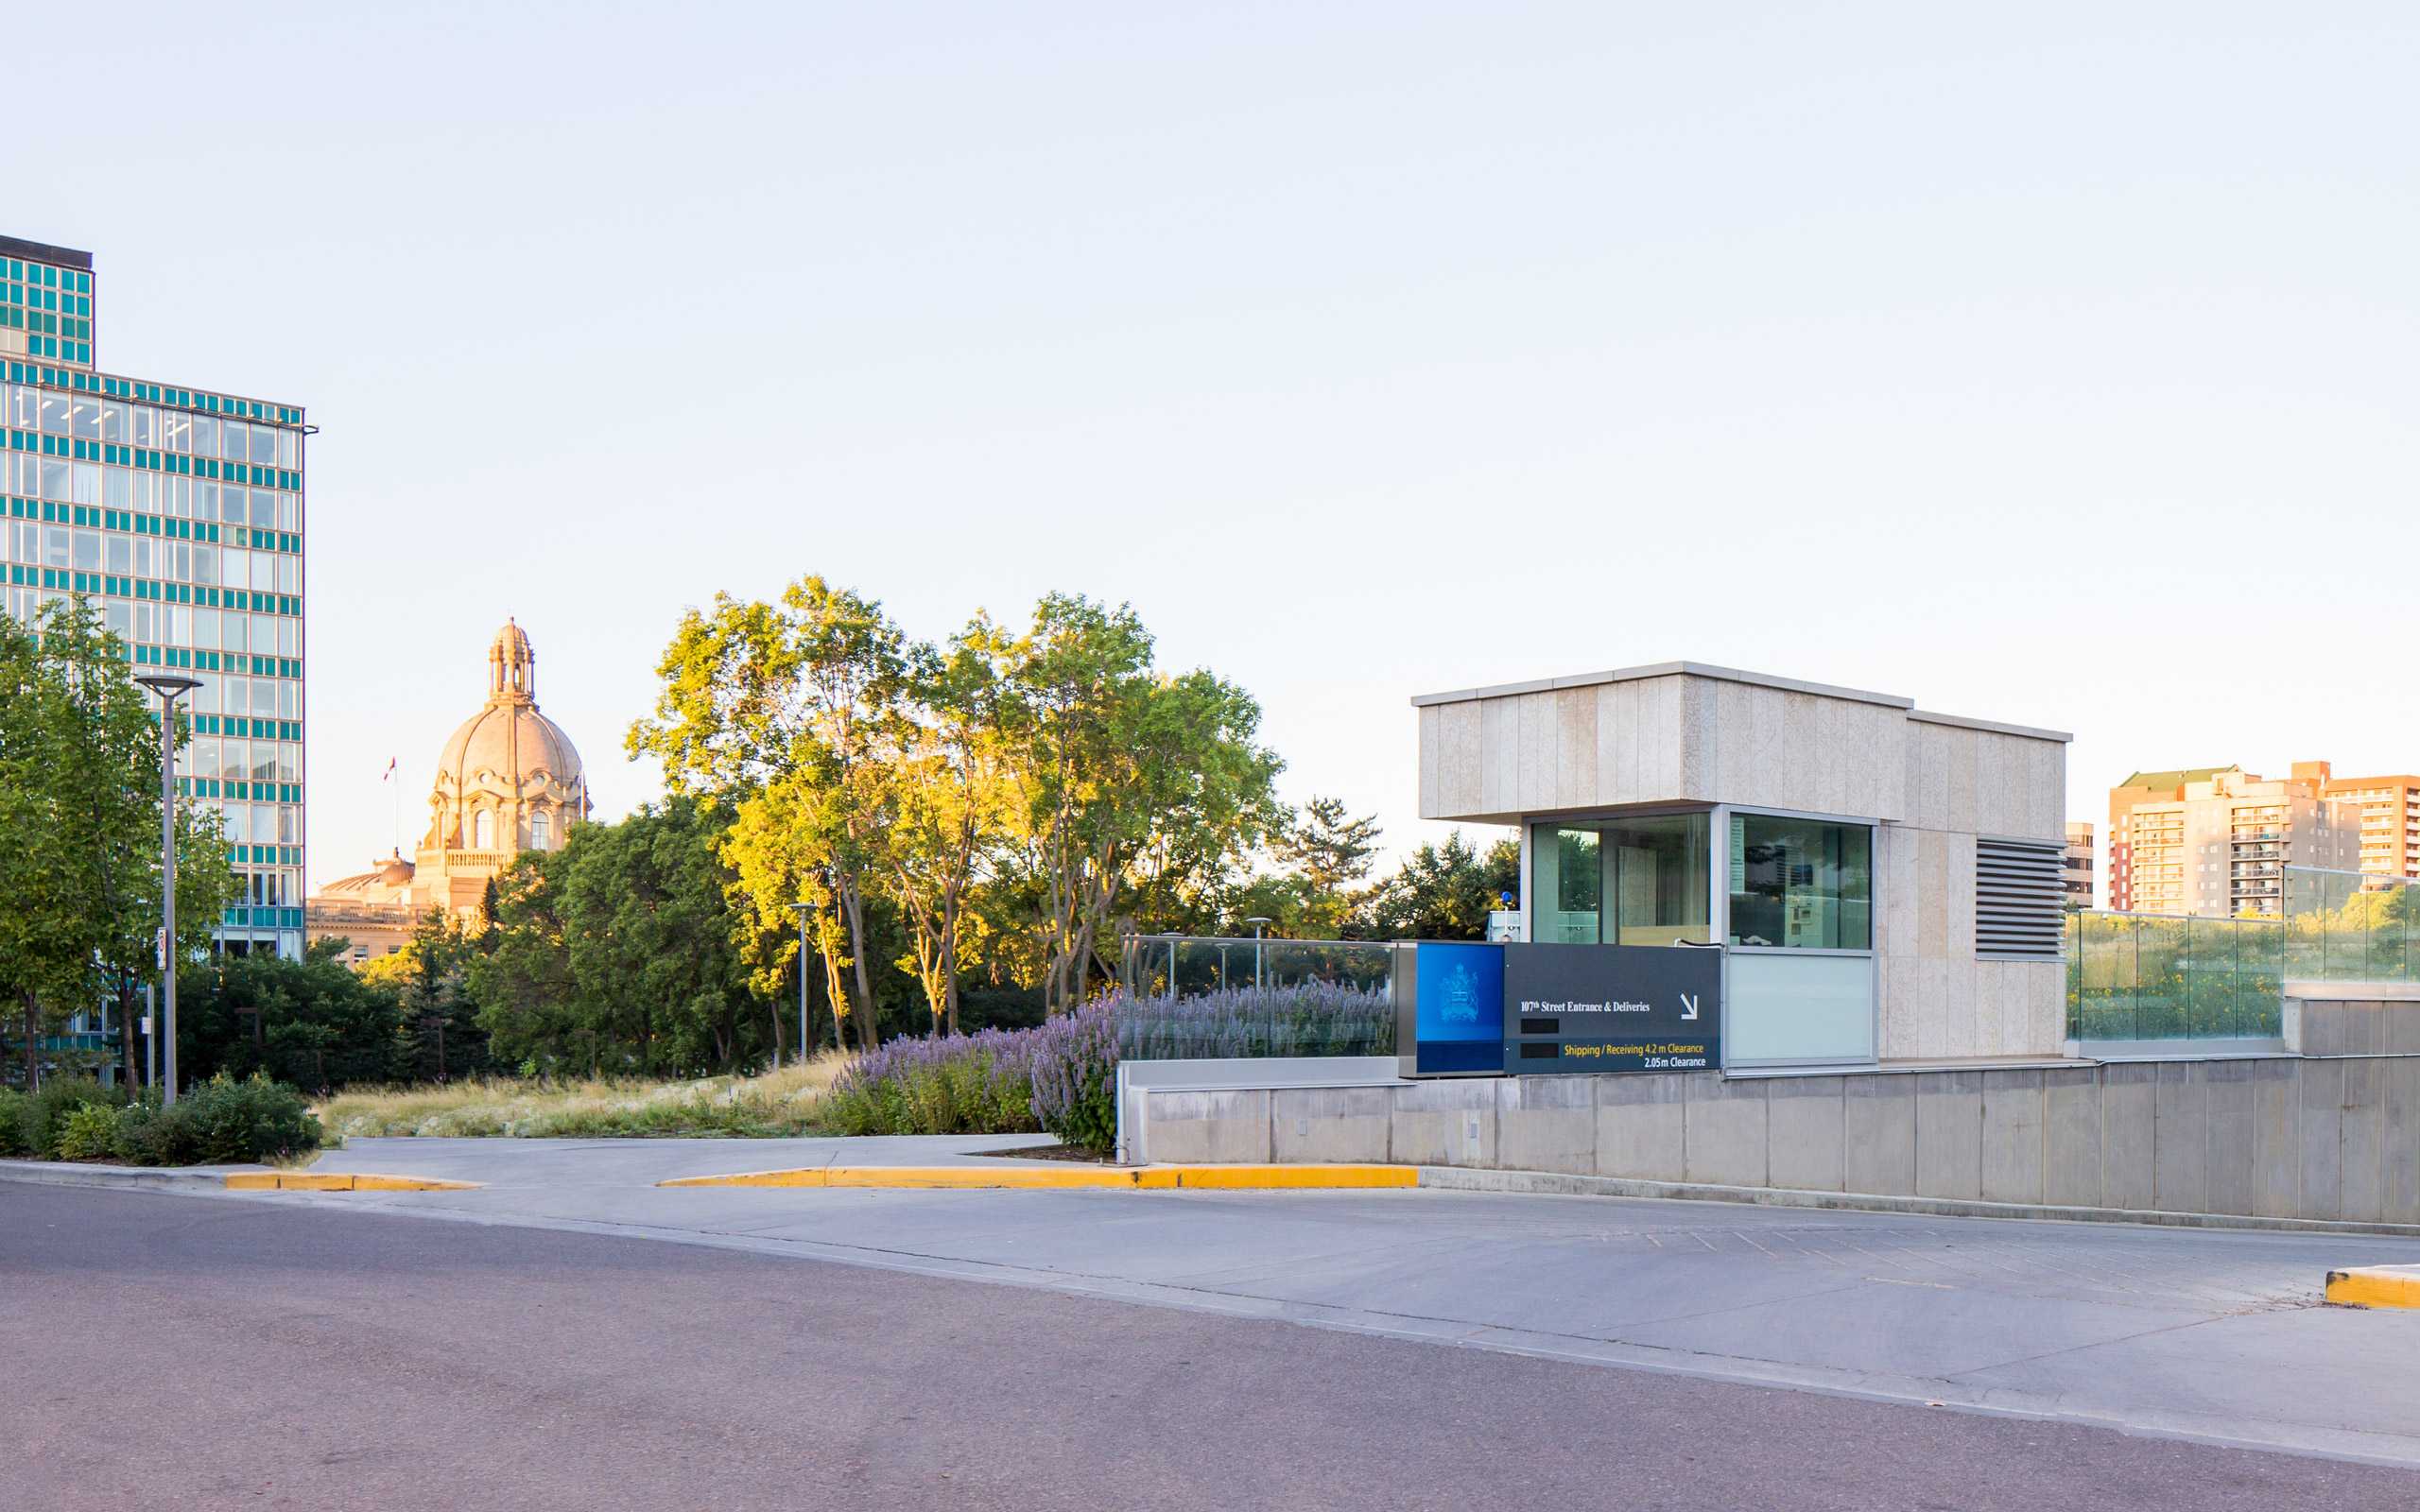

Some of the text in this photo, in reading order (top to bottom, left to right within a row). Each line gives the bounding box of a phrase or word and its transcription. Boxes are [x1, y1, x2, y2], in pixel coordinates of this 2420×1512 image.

[1521, 1001, 1651, 1012] 107th Street Entrance & Deliveries
[1564, 1044, 1600, 1057] Shipping
[1607, 1044, 1643, 1057] Receiving
[1645, 1043, 1657, 1054] 4.2
[1659, 1045, 1667, 1054] m
[1668, 1043, 1704, 1054] Clearance
[1645, 1057, 1706, 1068] 2.05m Clearance
